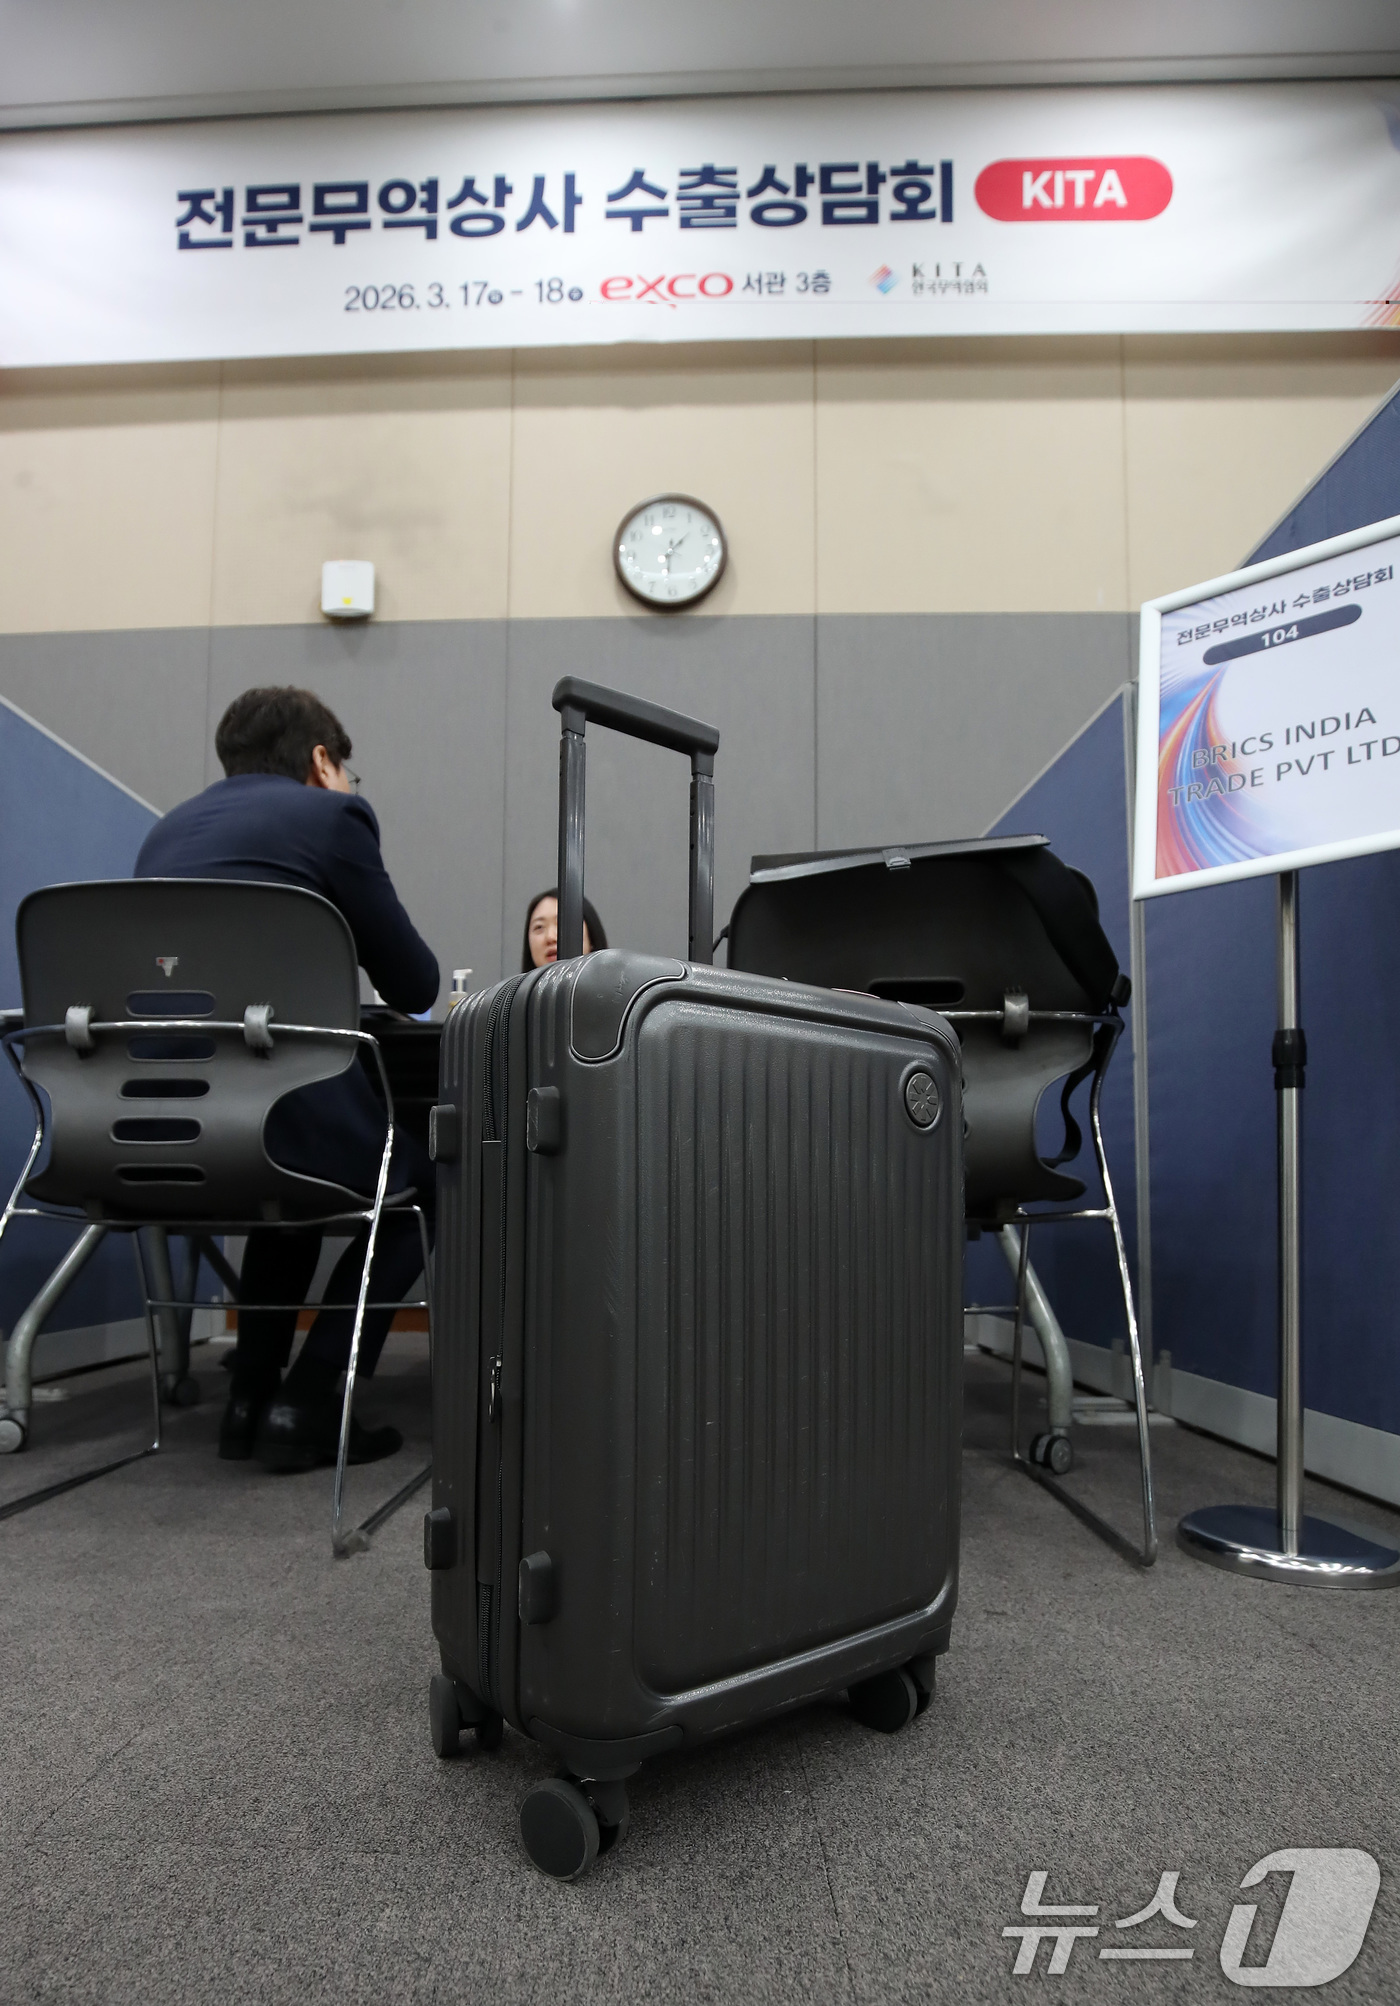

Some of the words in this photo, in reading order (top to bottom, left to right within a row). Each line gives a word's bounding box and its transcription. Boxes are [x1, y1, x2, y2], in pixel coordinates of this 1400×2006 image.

[175, 170, 583, 250] 전문무역상사
[604, 158, 955, 234] 수출상담회
[1021, 170, 1128, 210] KITA
[344, 283, 420, 311] 2026.
[742, 271, 787, 295] 서관
[796, 269, 832, 294] 3층
[1177, 600, 1286, 646] 전문무역상사
[1292, 564, 1394, 609] 수출상담회
[1261, 624, 1299, 648] 104
[1192, 732, 1274, 769] BRICS
[1285, 707, 1377, 745] INDIA
[1168, 768, 1264, 806] TRADE
[1276, 750, 1336, 783] PVT
[1347, 735, 1400, 765] LTD
